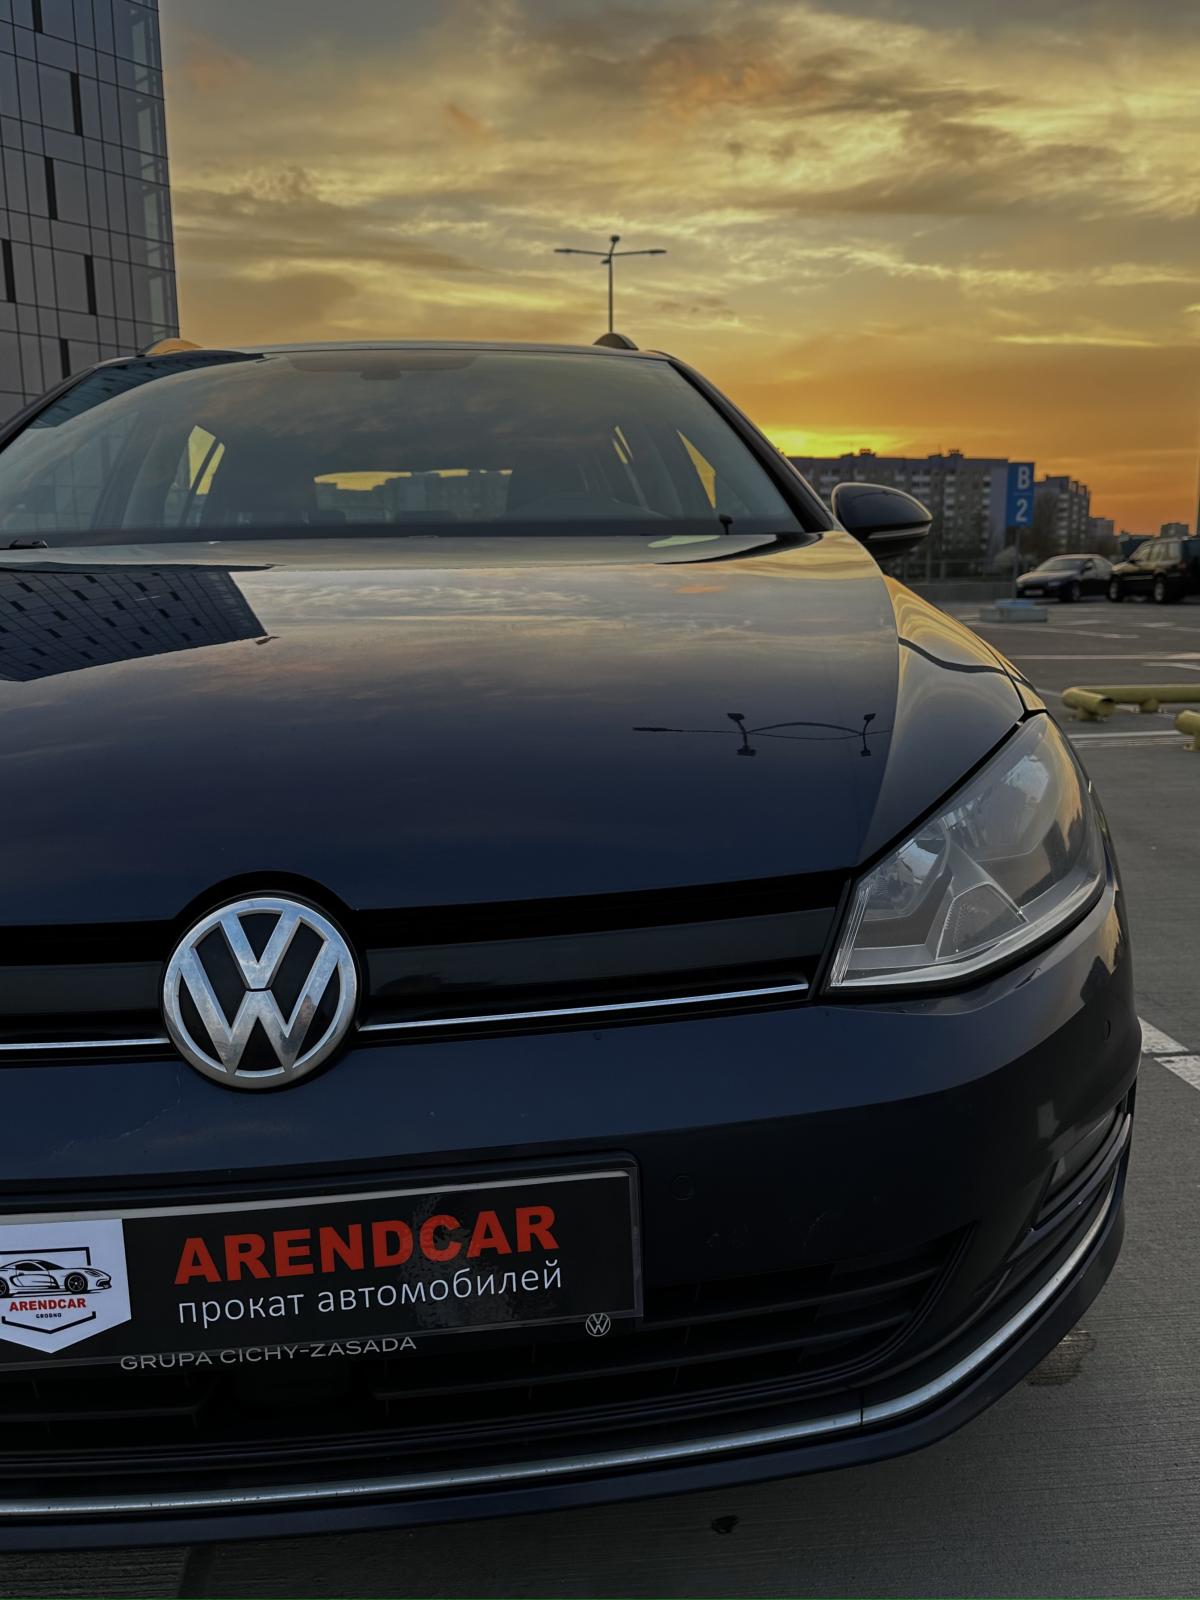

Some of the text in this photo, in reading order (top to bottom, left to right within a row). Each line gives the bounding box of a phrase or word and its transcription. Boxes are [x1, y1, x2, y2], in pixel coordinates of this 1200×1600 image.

[1017, 466, 1030, 490] B
[1015, 499, 1028, 522] 2
[174, 1205, 559, 1285] ARENDCAR
[9, 1298, 87, 1312] ARENDCAR
[179, 1258, 562, 1329] прокат автомобилей
[120, 1336, 417, 1371] GRUPA CICHY-ZASADA
